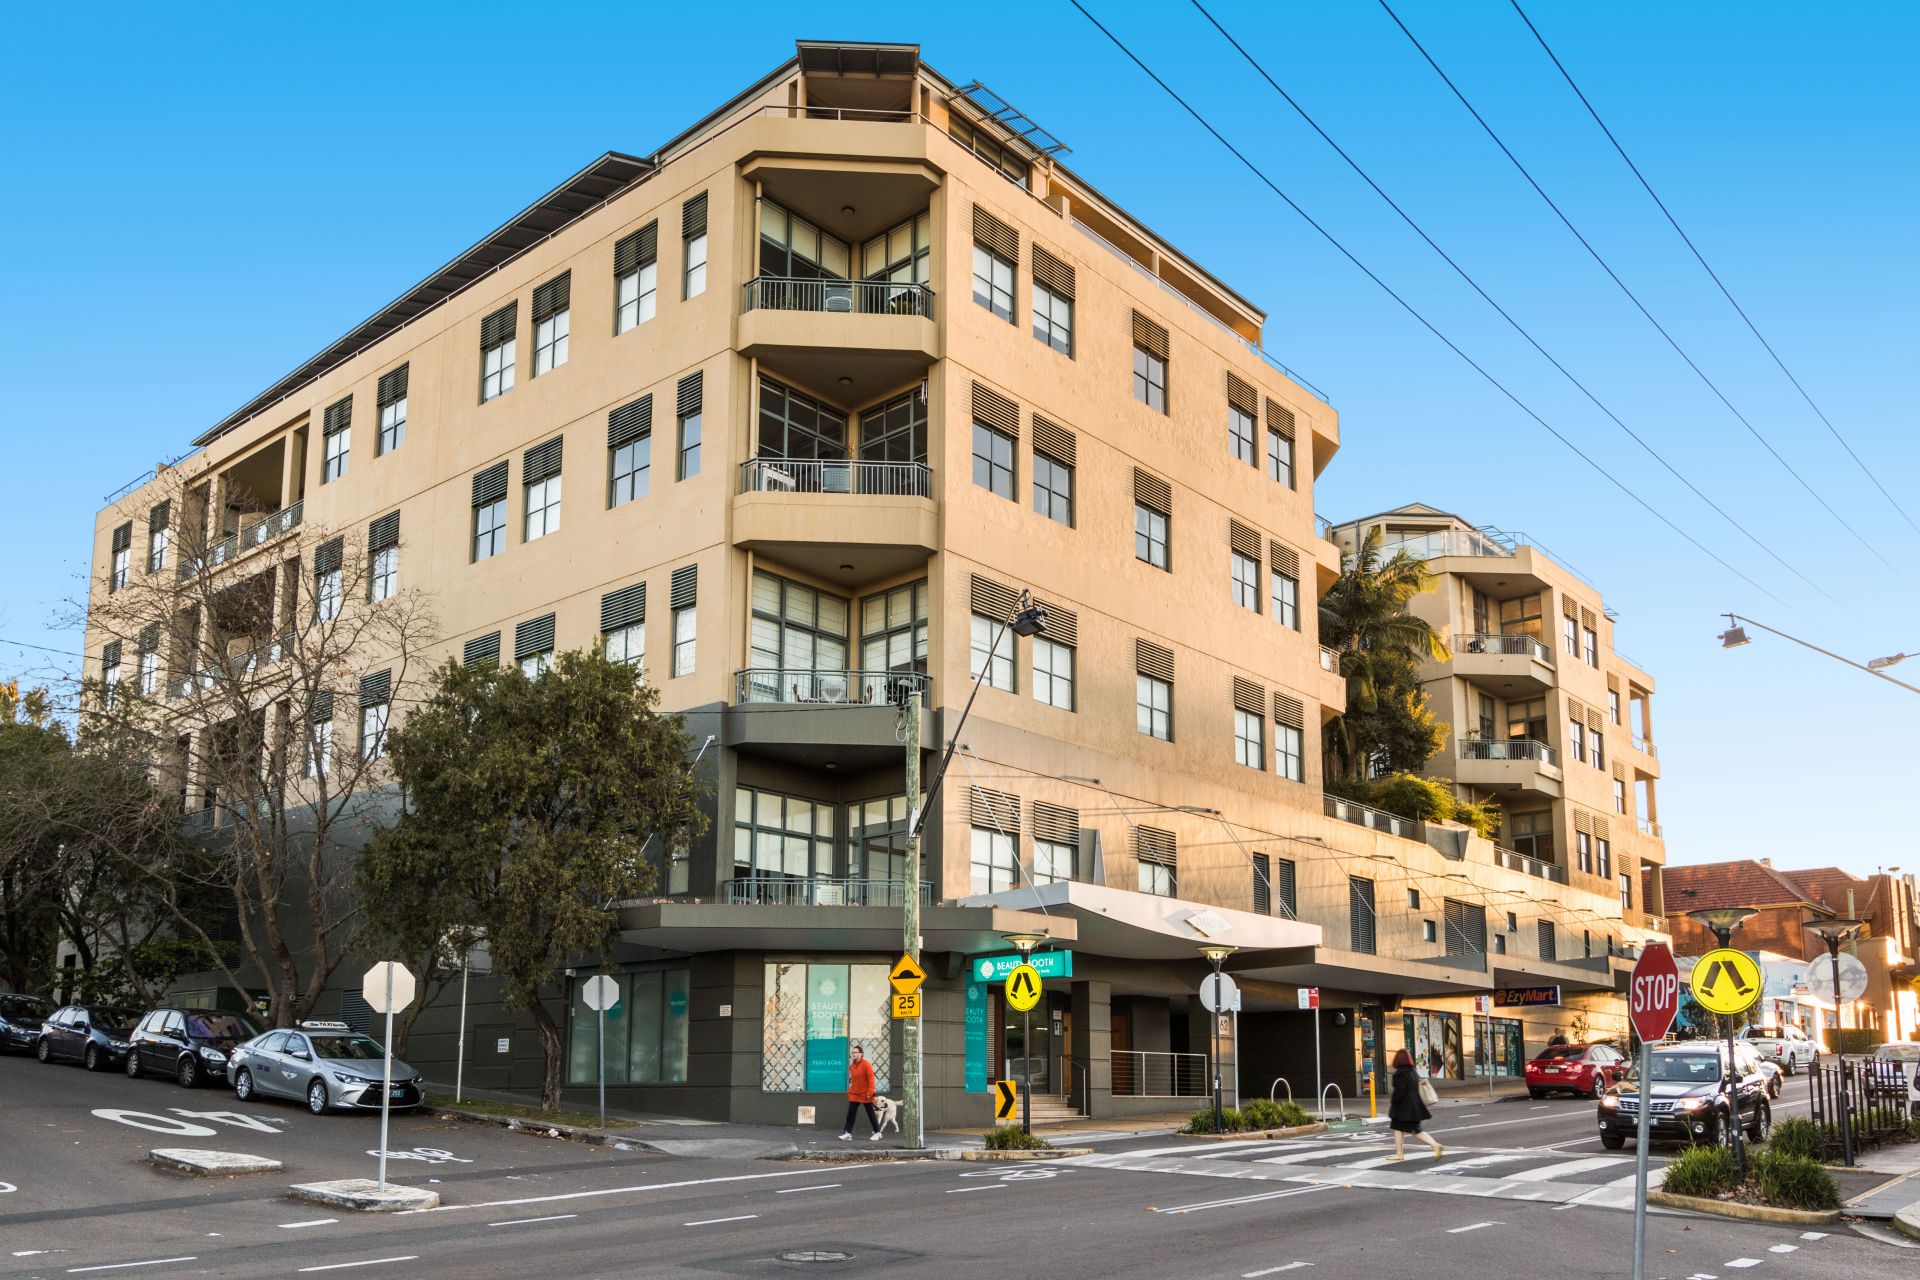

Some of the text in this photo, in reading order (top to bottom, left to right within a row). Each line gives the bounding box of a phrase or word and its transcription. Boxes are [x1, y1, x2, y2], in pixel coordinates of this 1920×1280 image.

[1507, 989, 1554, 1005] EzyMart
[1634, 973, 1677, 1013] STOP
[811, 1002, 845, 1011] BEAUTY
[898, 996, 915, 1009] 25
[812, 1011, 844, 1019] BOOTH
[965, 1007, 984, 1016] EAUTY
[965, 1016, 983, 1024] OOTH
